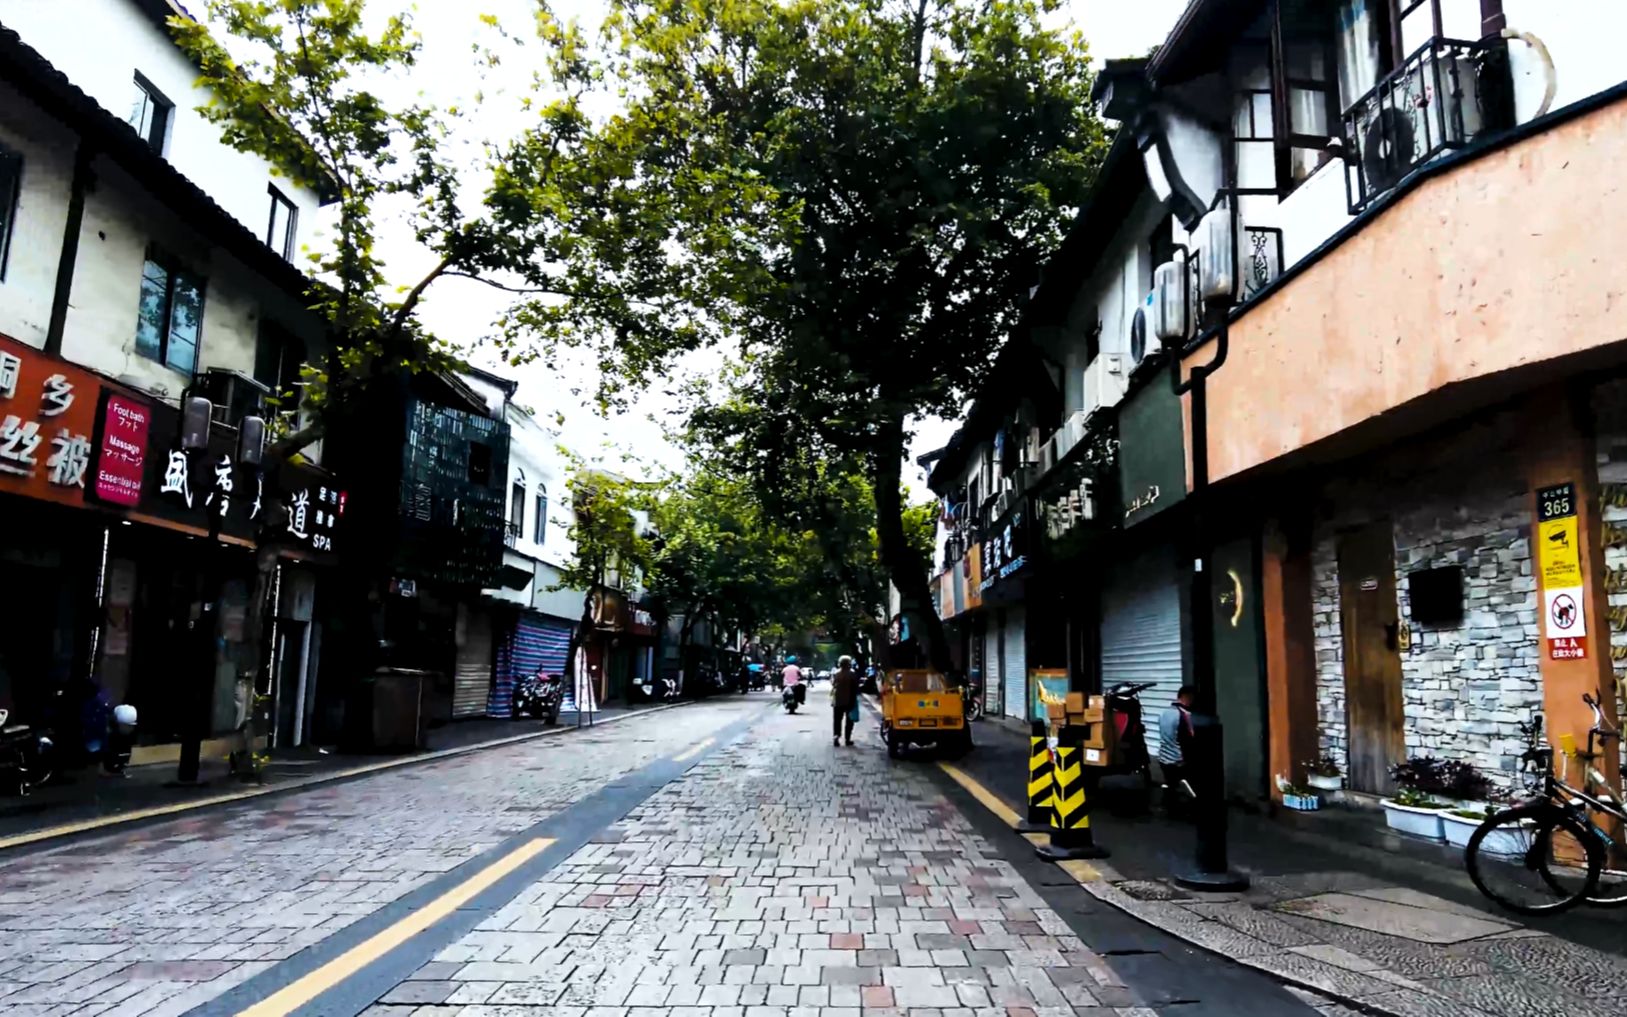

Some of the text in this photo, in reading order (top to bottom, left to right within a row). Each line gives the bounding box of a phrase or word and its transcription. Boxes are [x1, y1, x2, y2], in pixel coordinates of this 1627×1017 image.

[113, 402, 145, 423] Foot bath
[109, 434, 140, 455] Massage
[99, 469, 142, 491] Essential oil
[1544, 497, 1570, 516] 365
[312, 533, 332, 551] SPA
